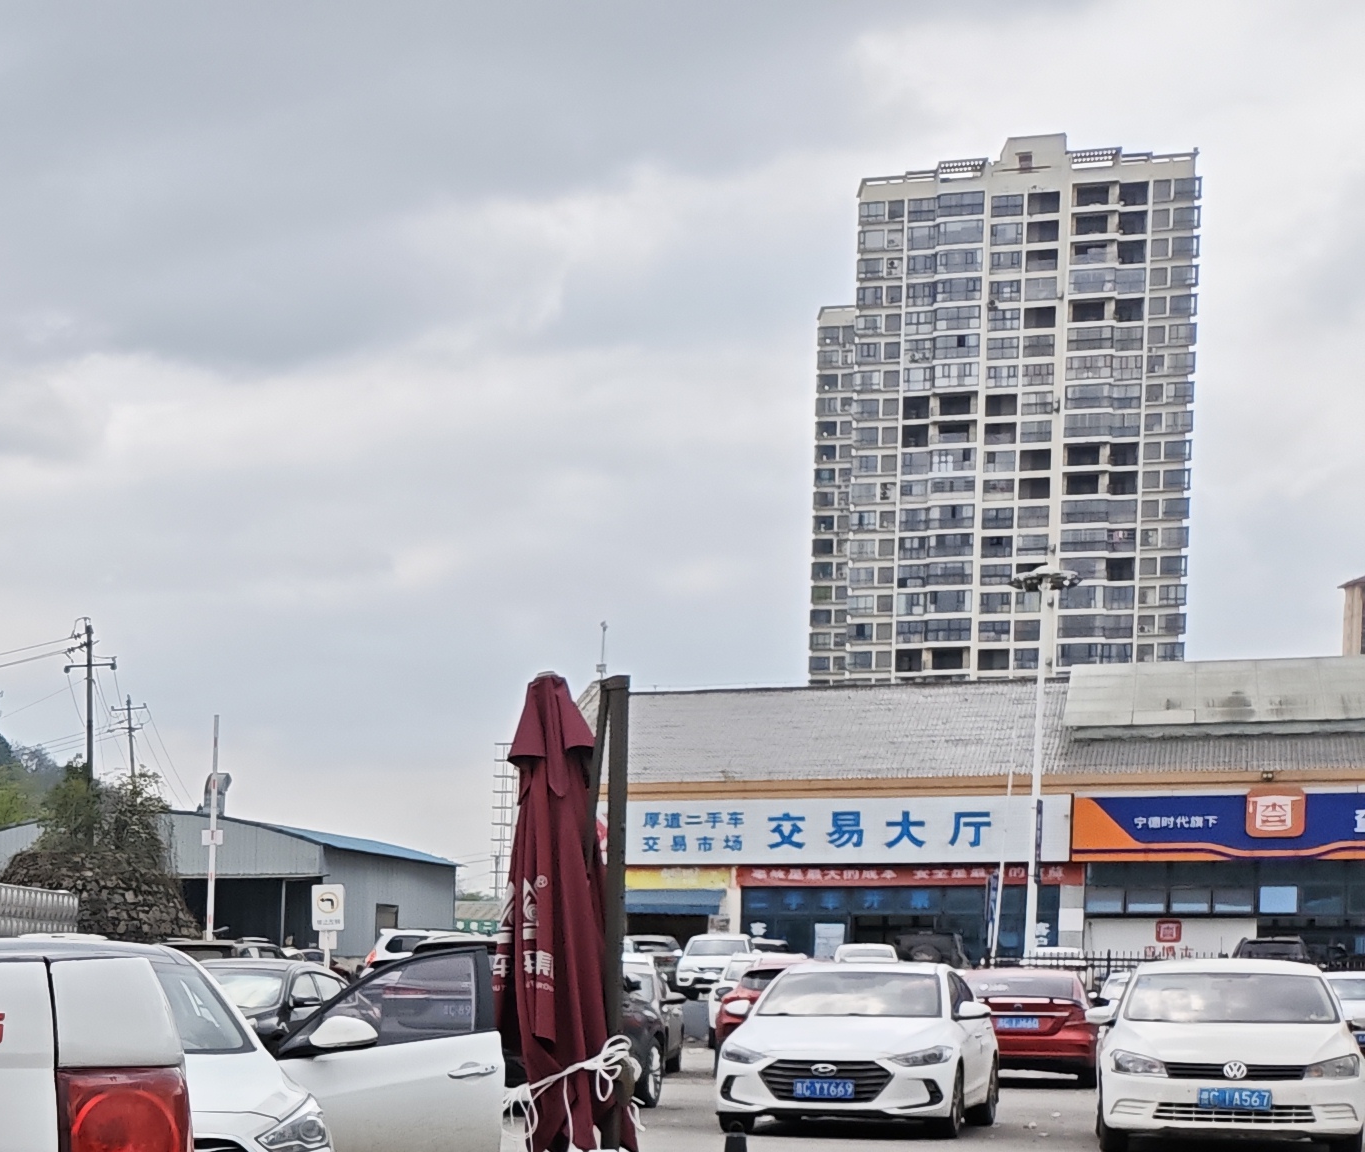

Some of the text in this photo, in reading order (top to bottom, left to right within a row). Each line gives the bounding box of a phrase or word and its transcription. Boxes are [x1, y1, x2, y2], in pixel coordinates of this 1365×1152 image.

[643, 812, 745, 829] 厚道二手车
[1133, 815, 1219, 830] 宁德时代旗下
[767, 811, 993, 849] 交易大厅
[642, 835, 743, 852] 交易市场
